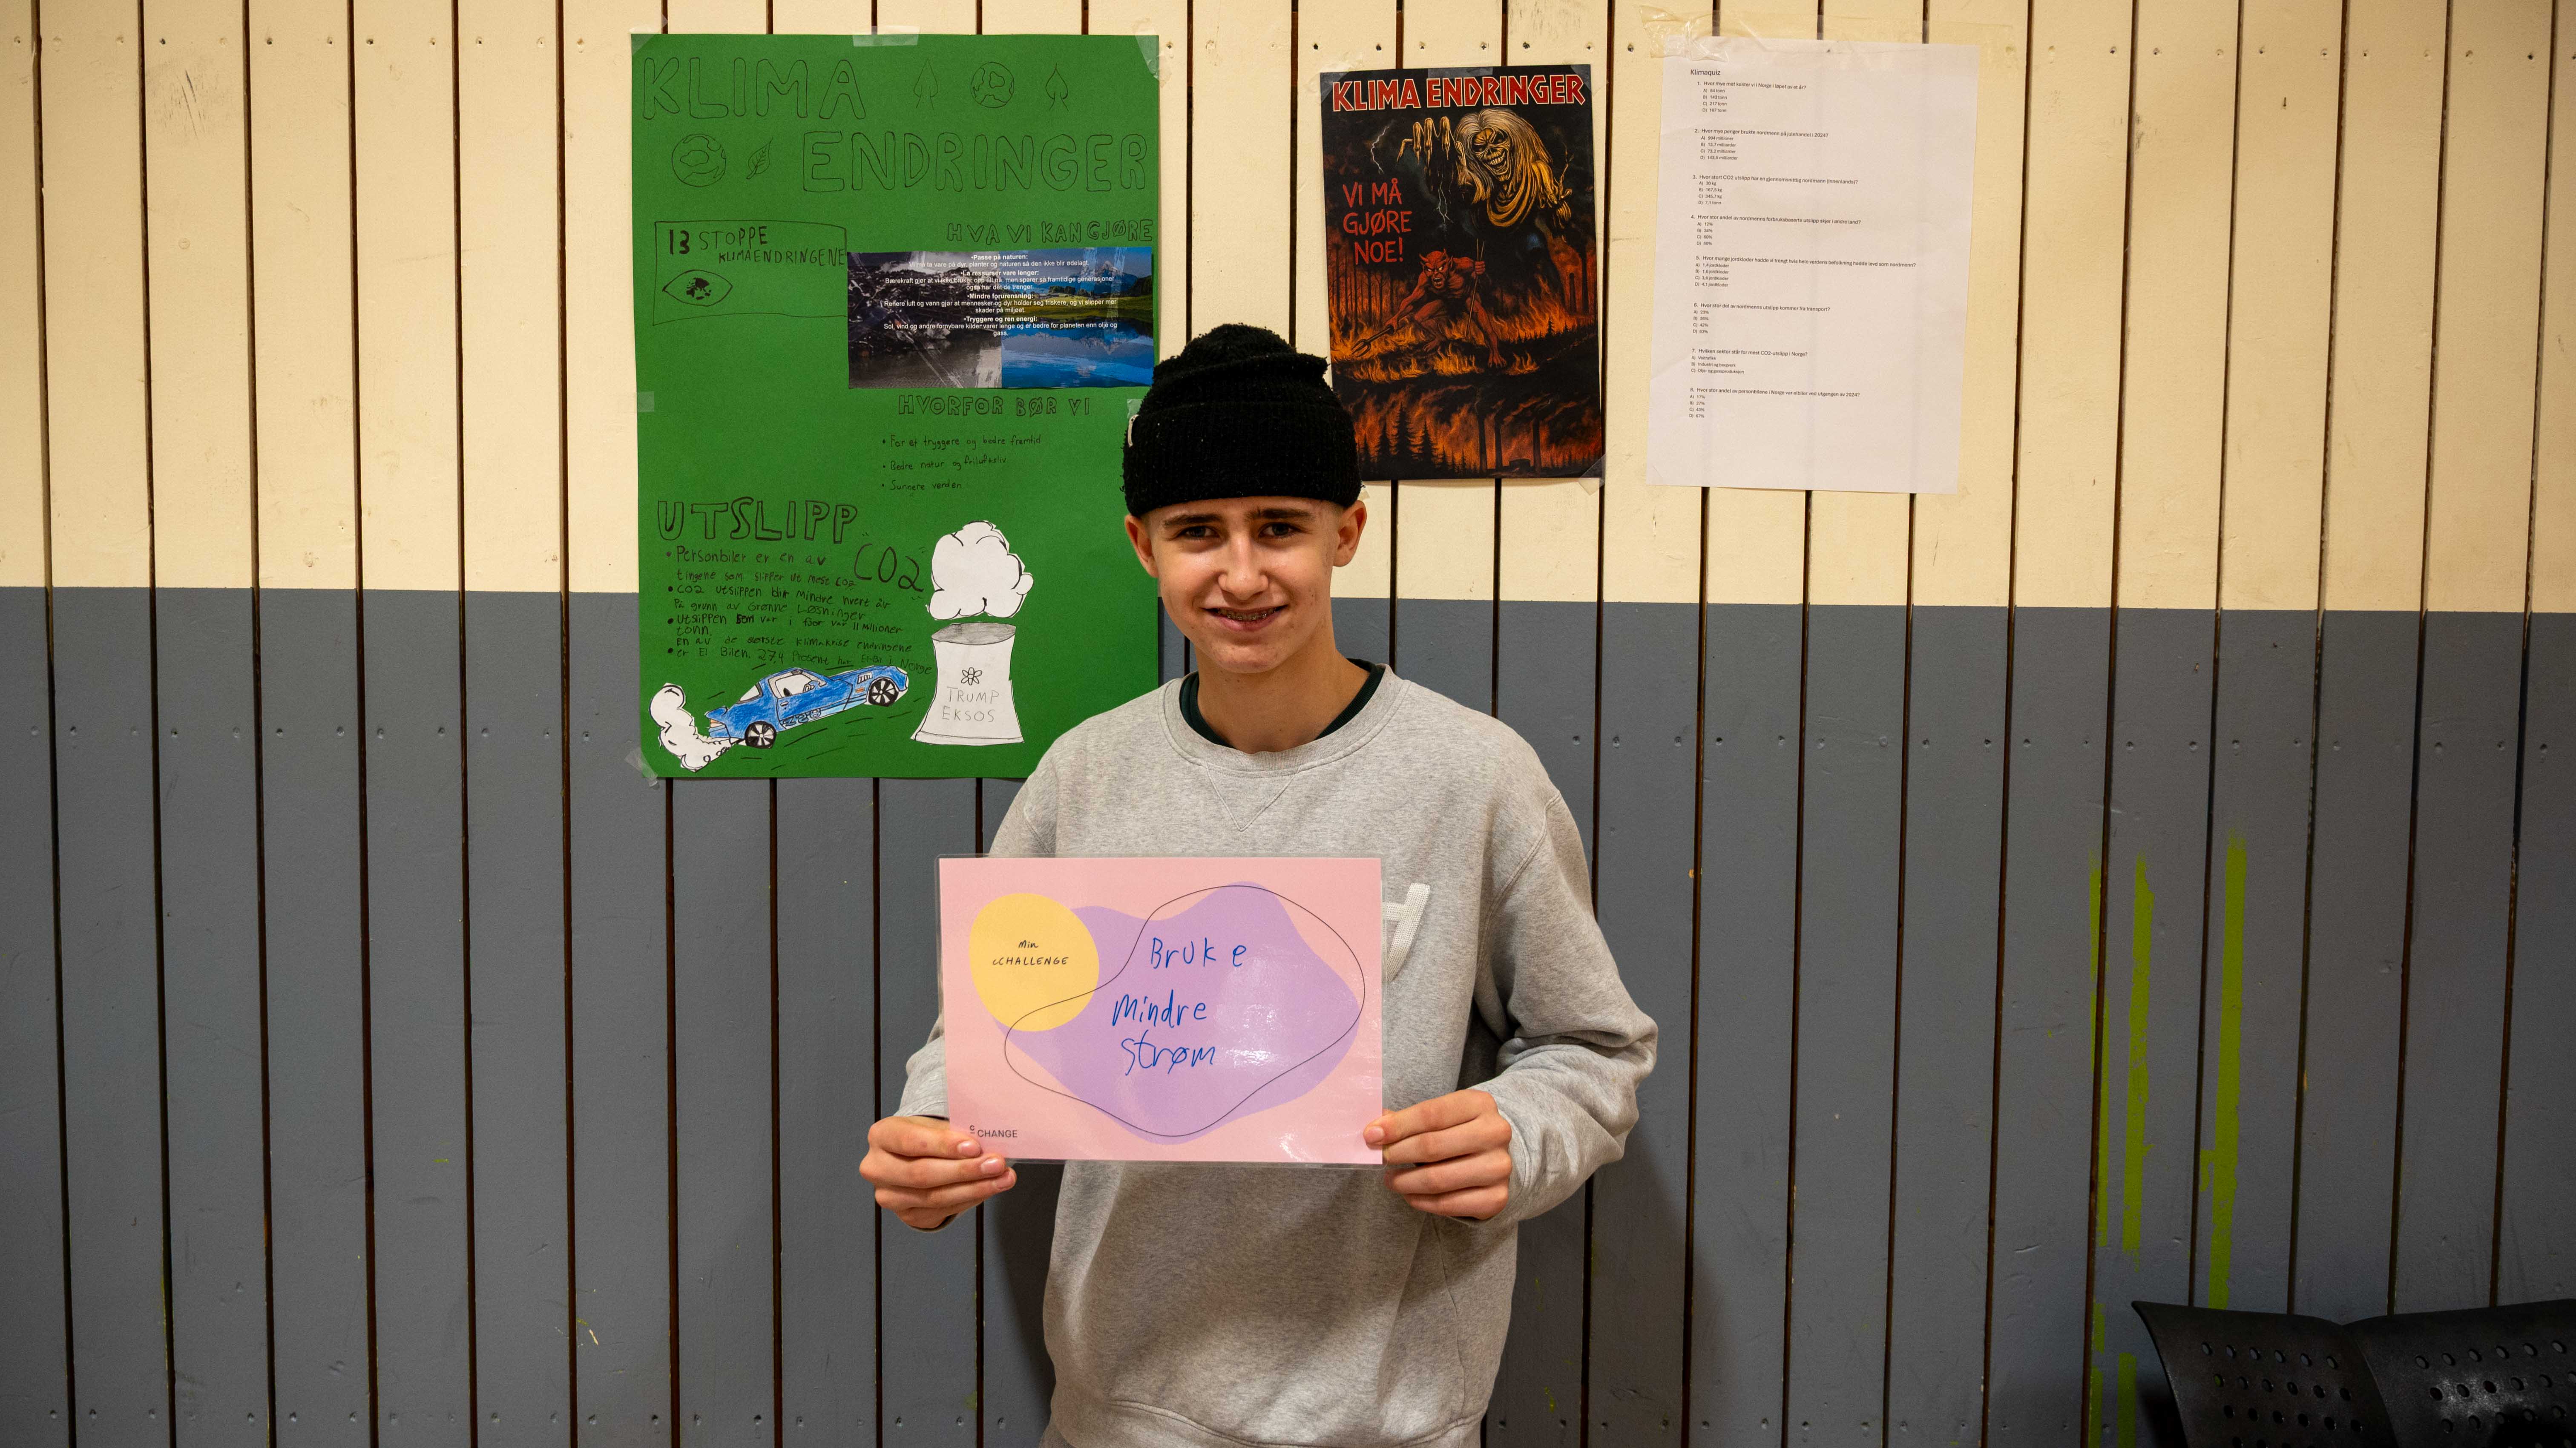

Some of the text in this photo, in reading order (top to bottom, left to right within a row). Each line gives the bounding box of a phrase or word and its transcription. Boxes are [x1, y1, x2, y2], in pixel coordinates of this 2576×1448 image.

[642, 56, 866, 120] KLIMA
[1332, 74, 1585, 112] KLIMA ENDRINGER
[803, 130, 1148, 192] ENDRINGER
[1343, 178, 1402, 208] VI MÅ
[947, 219, 1153, 245] HVA VI KAN GJØRE
[1343, 209, 1412, 237] GJØRE
[670, 226, 768, 255] 13 STOPPE
[1354, 238, 1404, 265] NOE!
[719, 248, 845, 266] KLIMAENDRINGENE
[898, 395, 1090, 417] HVORFOR BØR VI
[923, 437, 959, 451] tryggere
[966, 438, 976, 450] og
[983, 435, 1005, 445] bedre
[920, 460, 945, 469] natur
[964, 456, 1007, 466] friluftsliv
[657, 497, 858, 544] UTSLIPP
[854, 543, 924, 592] CO2
[946, 686, 1000, 705] TRUMP
[942, 706, 995, 722] EKSOS
[978, 1129, 1018, 1138] CHANGE
